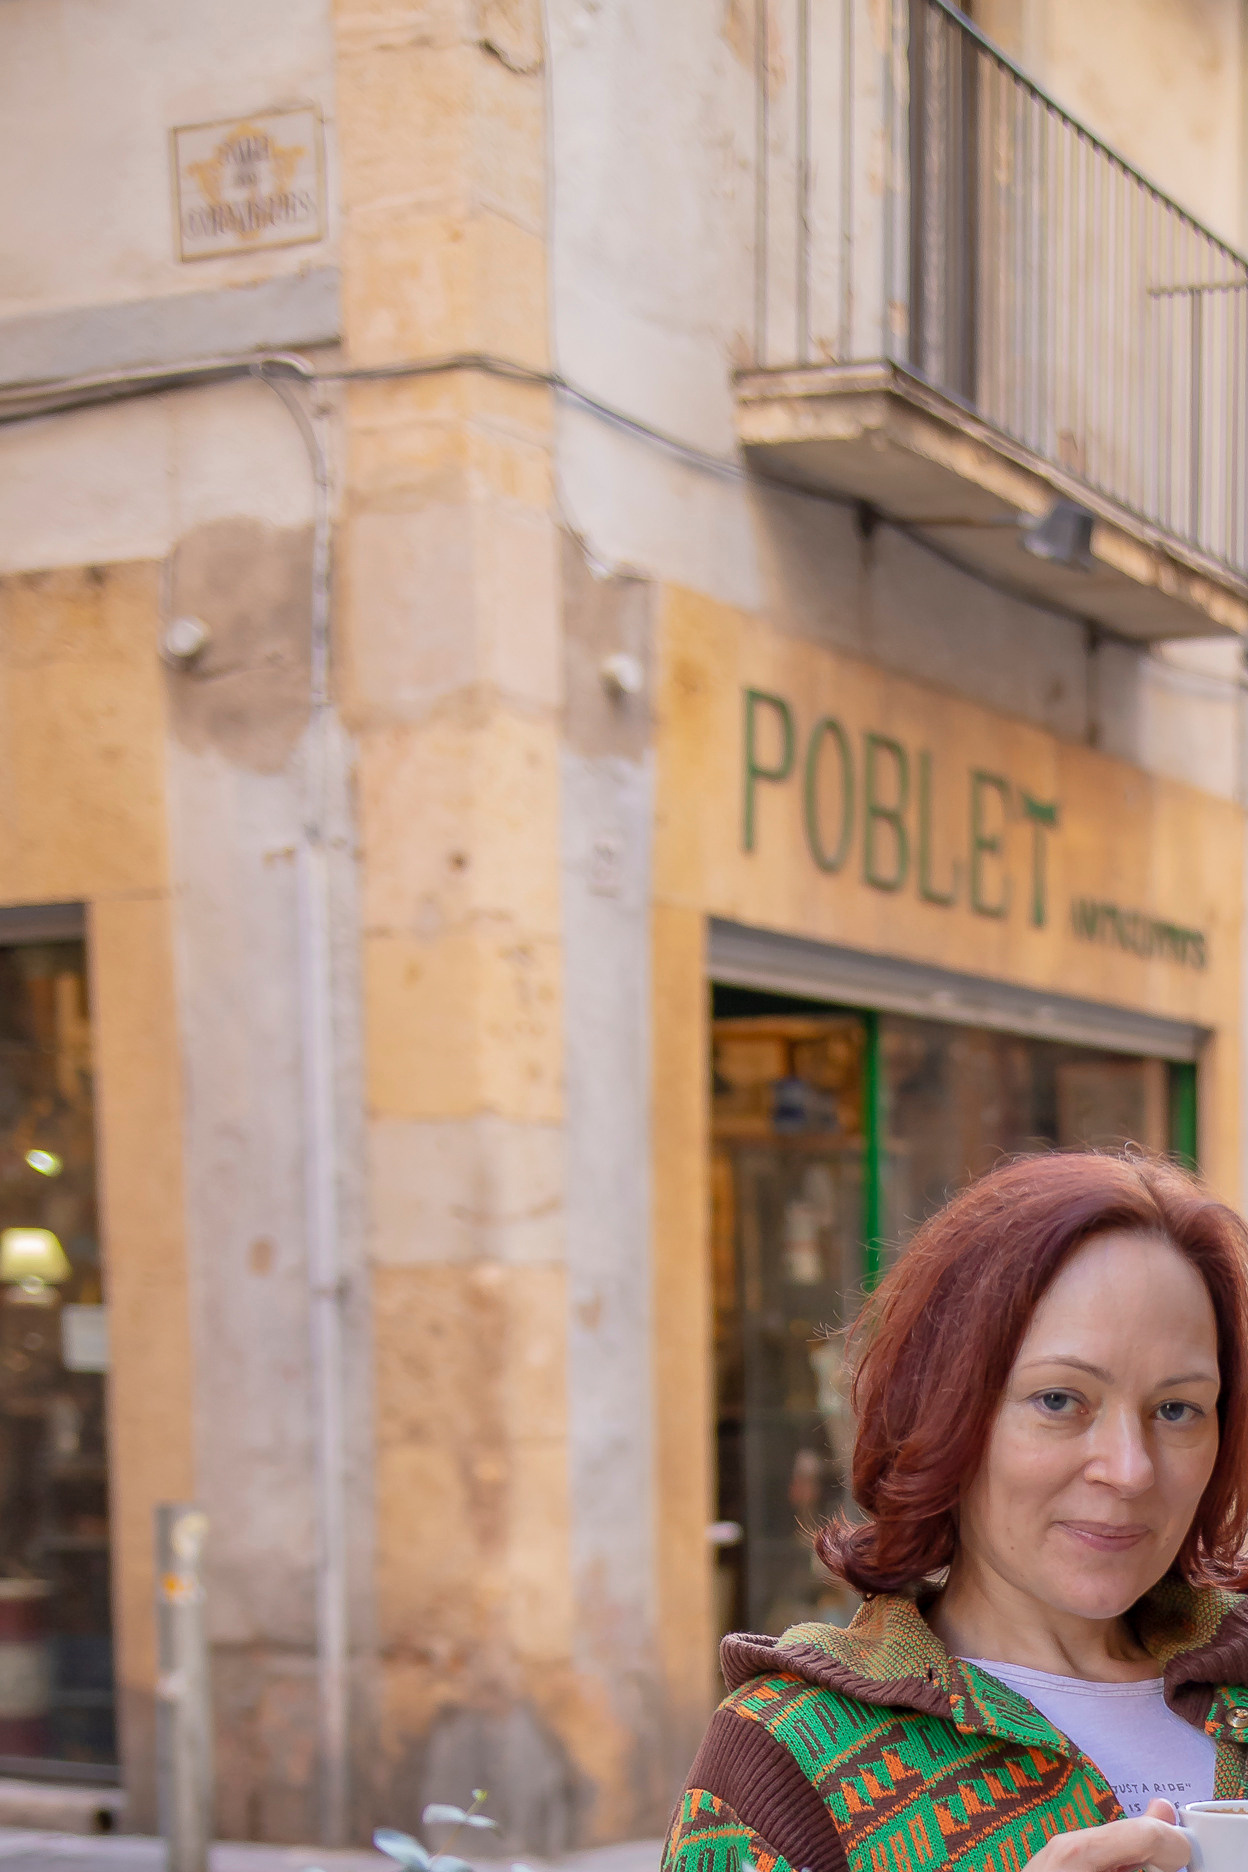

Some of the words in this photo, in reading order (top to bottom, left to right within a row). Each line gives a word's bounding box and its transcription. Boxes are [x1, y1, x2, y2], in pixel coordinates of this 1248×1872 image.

[742, 688, 1057, 927] POBLET
[1110, 1783, 1139, 1794] JUST
[1142, 1783, 1150, 1793] A
